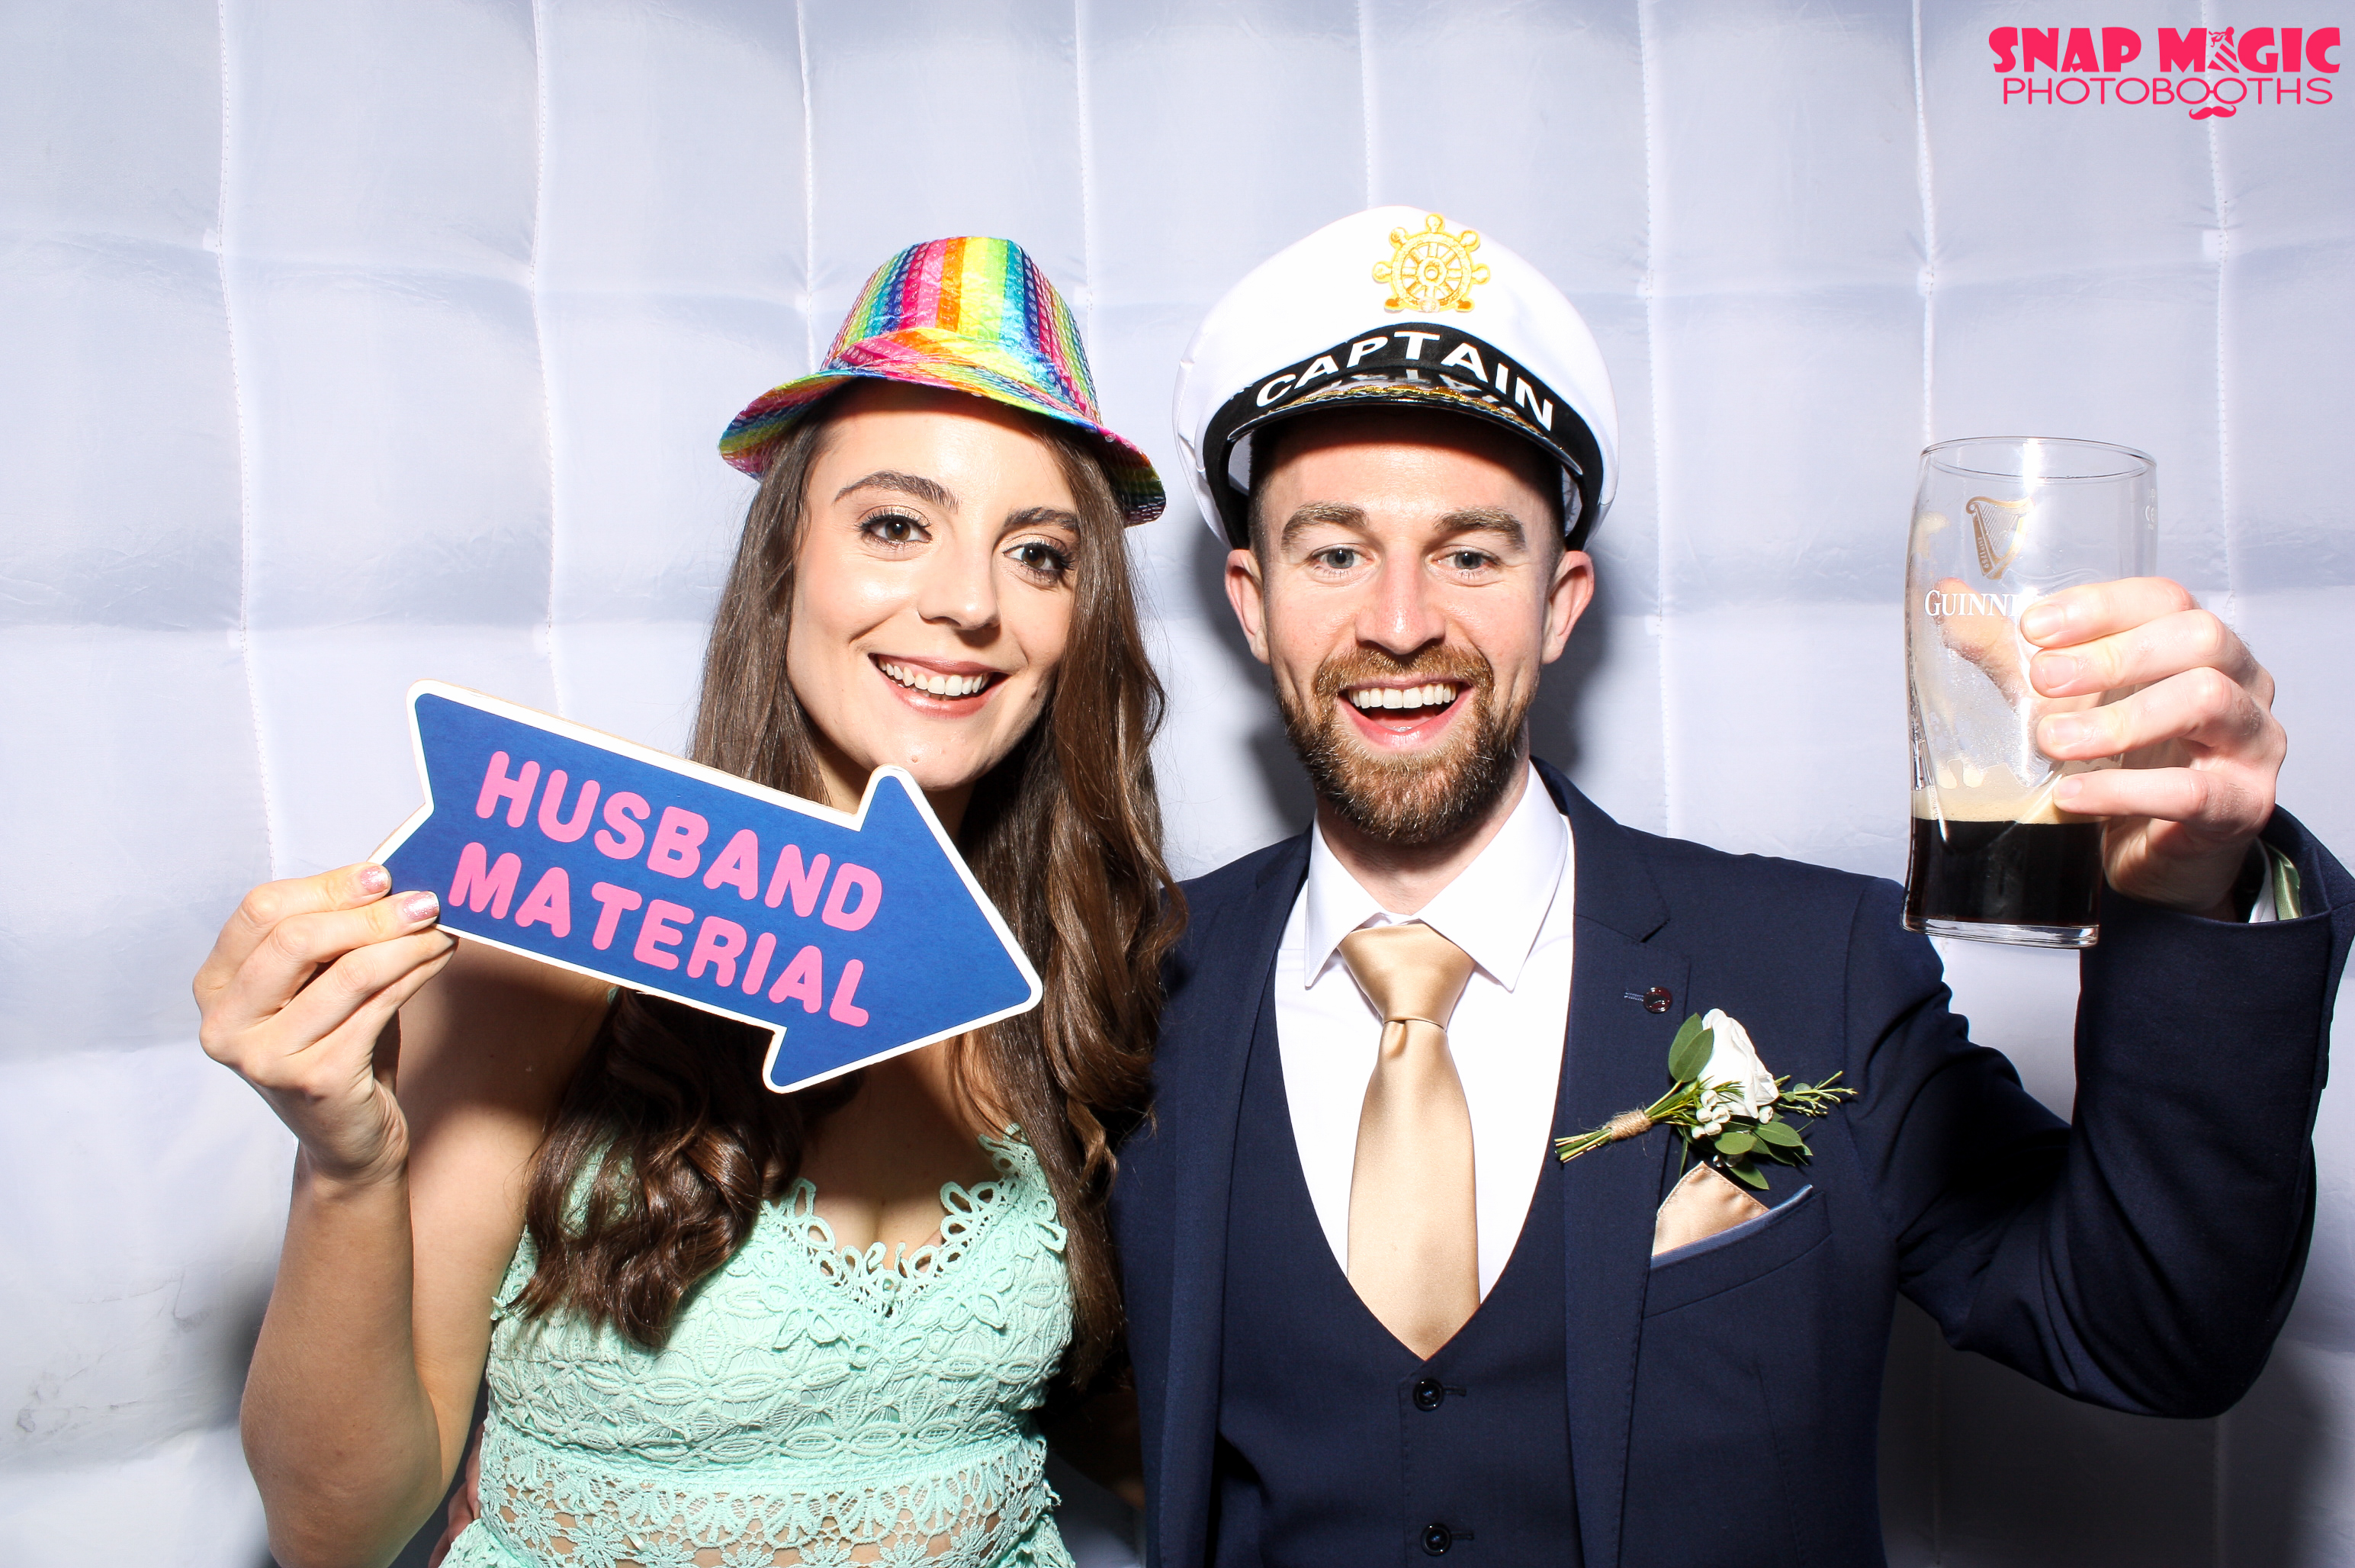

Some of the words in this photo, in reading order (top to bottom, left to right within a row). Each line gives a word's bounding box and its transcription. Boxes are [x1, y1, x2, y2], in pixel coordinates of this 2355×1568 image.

[1256, 330, 1553, 432] CAPTAIN
[1924, 589, 2044, 618] GUINNE
[475, 750, 882, 932] HUSBAND
[448, 841, 869, 1027] MATERIAL
